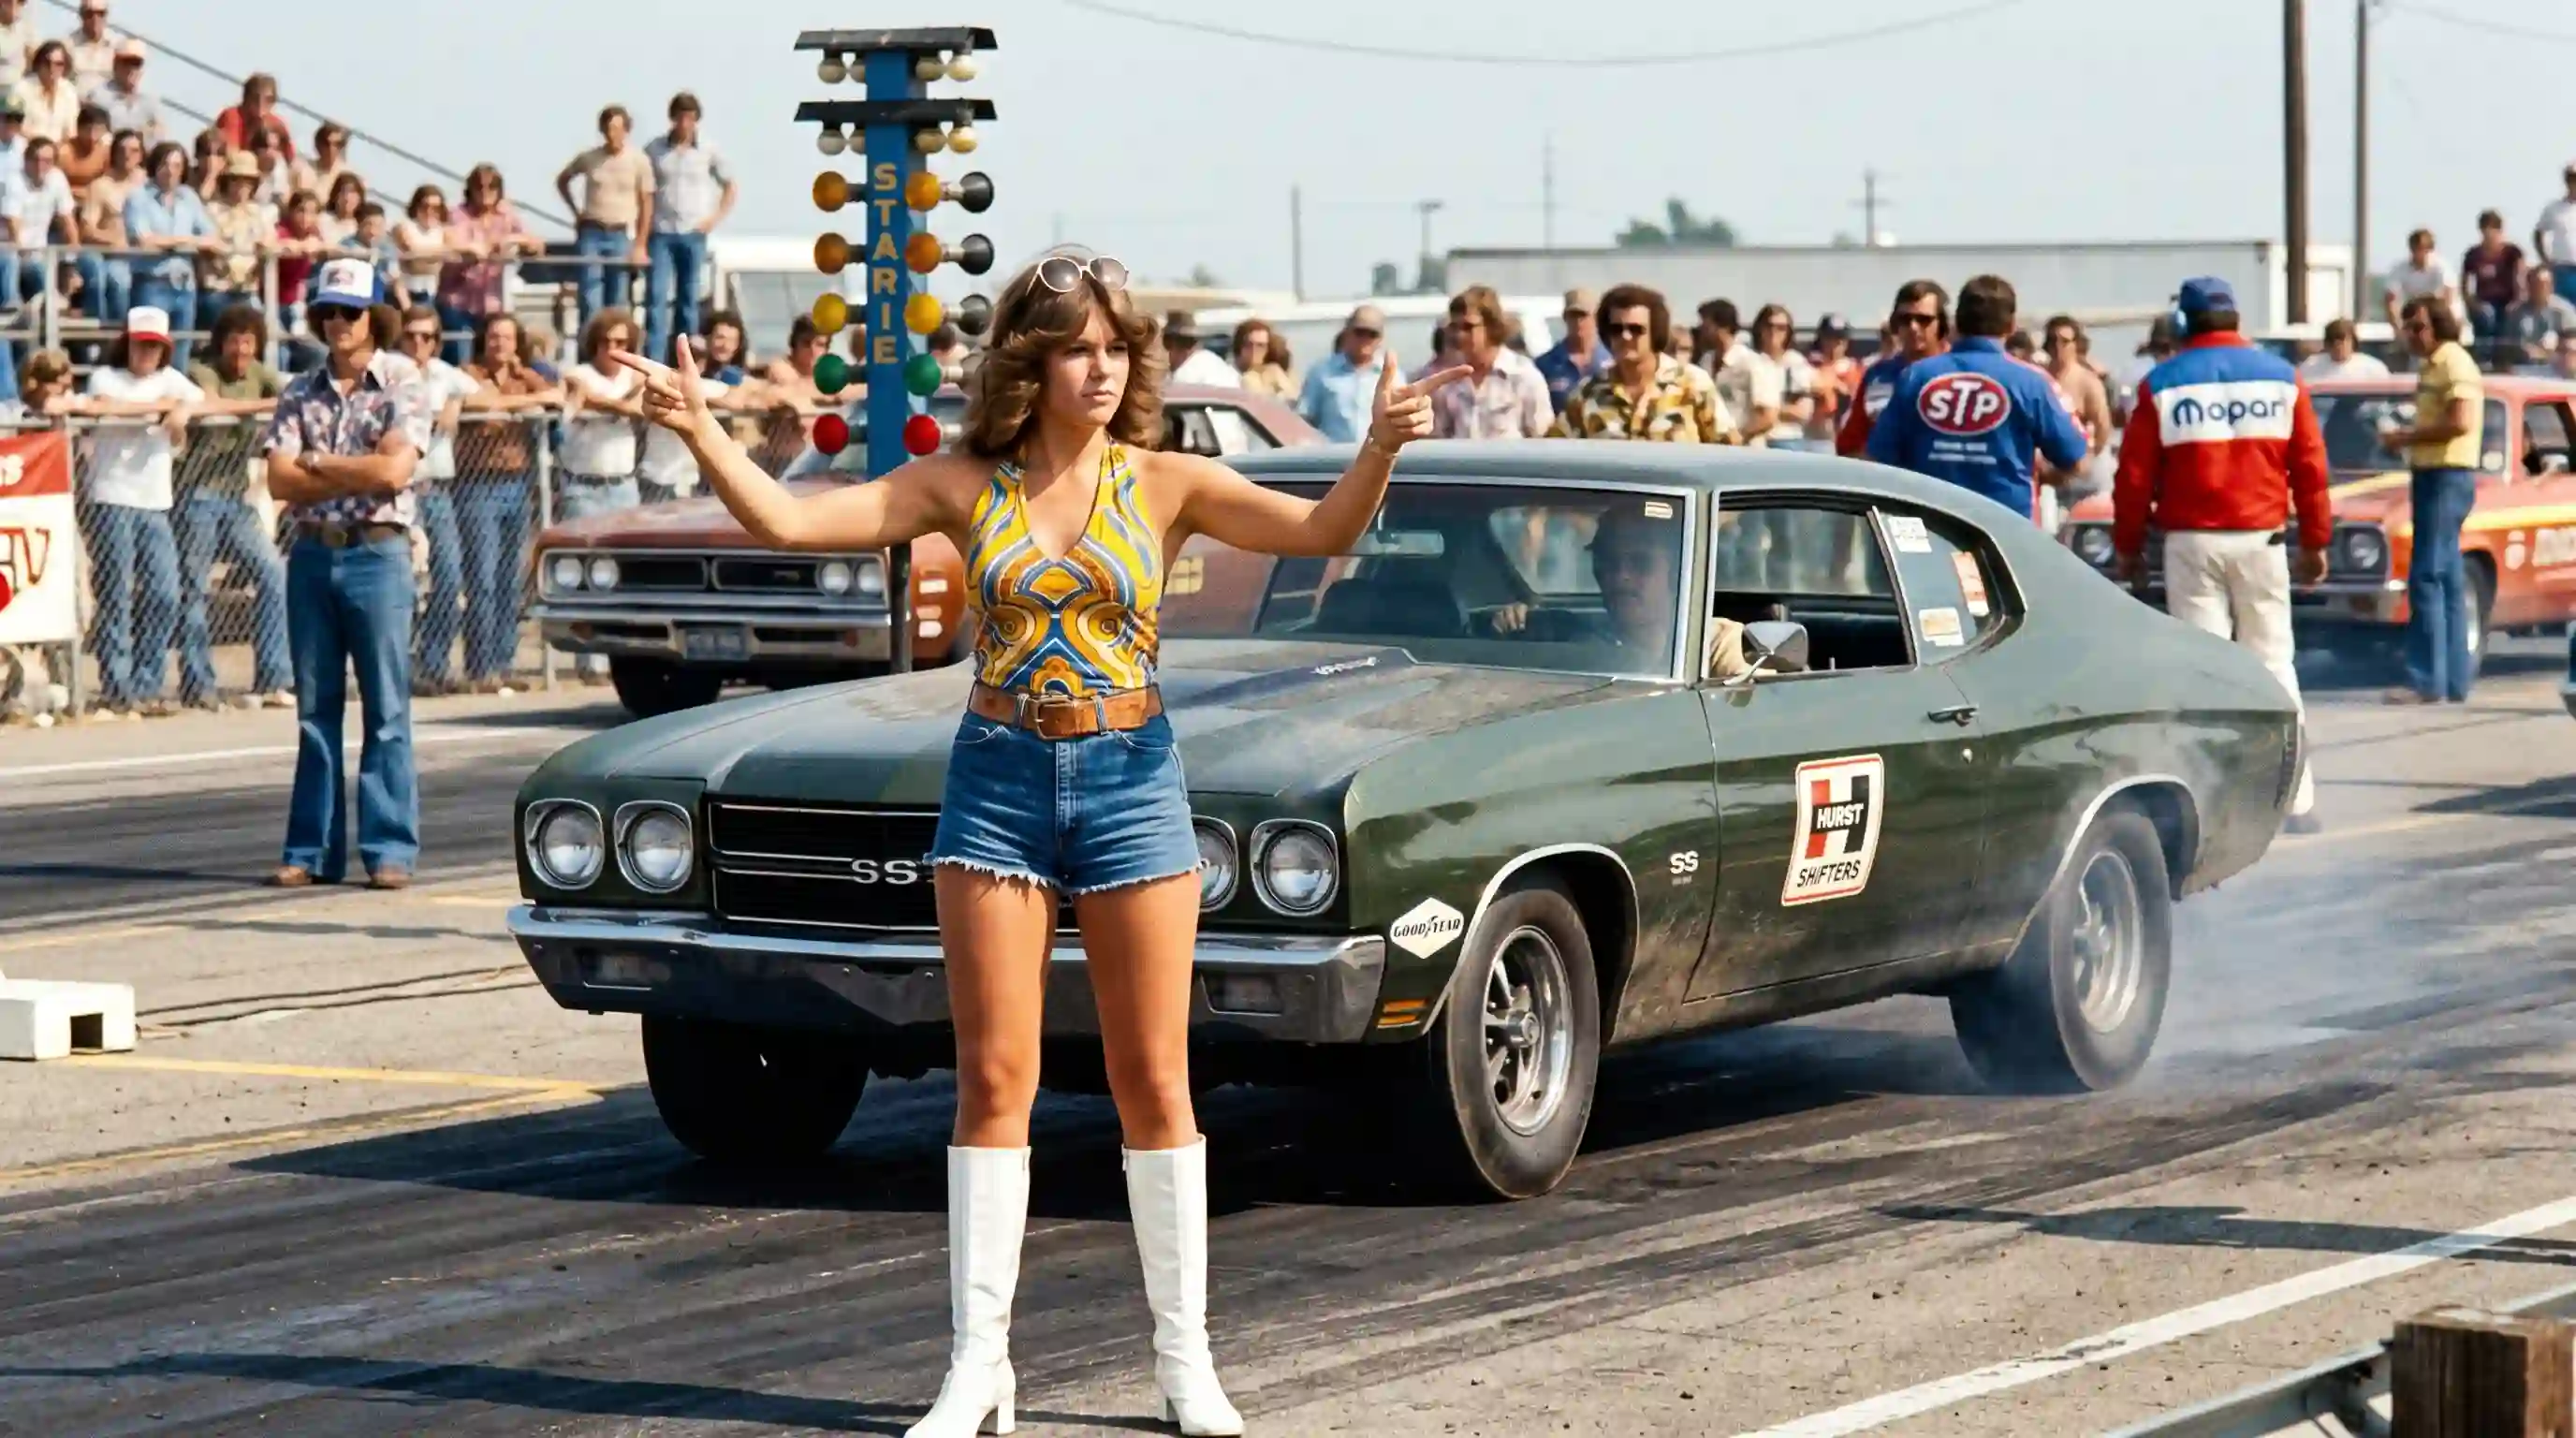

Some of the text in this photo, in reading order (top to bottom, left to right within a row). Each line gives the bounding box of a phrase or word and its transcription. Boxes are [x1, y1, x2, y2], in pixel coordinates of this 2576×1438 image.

[872, 162, 900, 364] STARIE
[1927, 379, 2000, 426] STP
[1816, 803, 1864, 829] HURST
[852, 859, 917, 885] SS
[1669, 850, 1699, 873] SS
[1797, 859, 1862, 888] SHIFTERS
